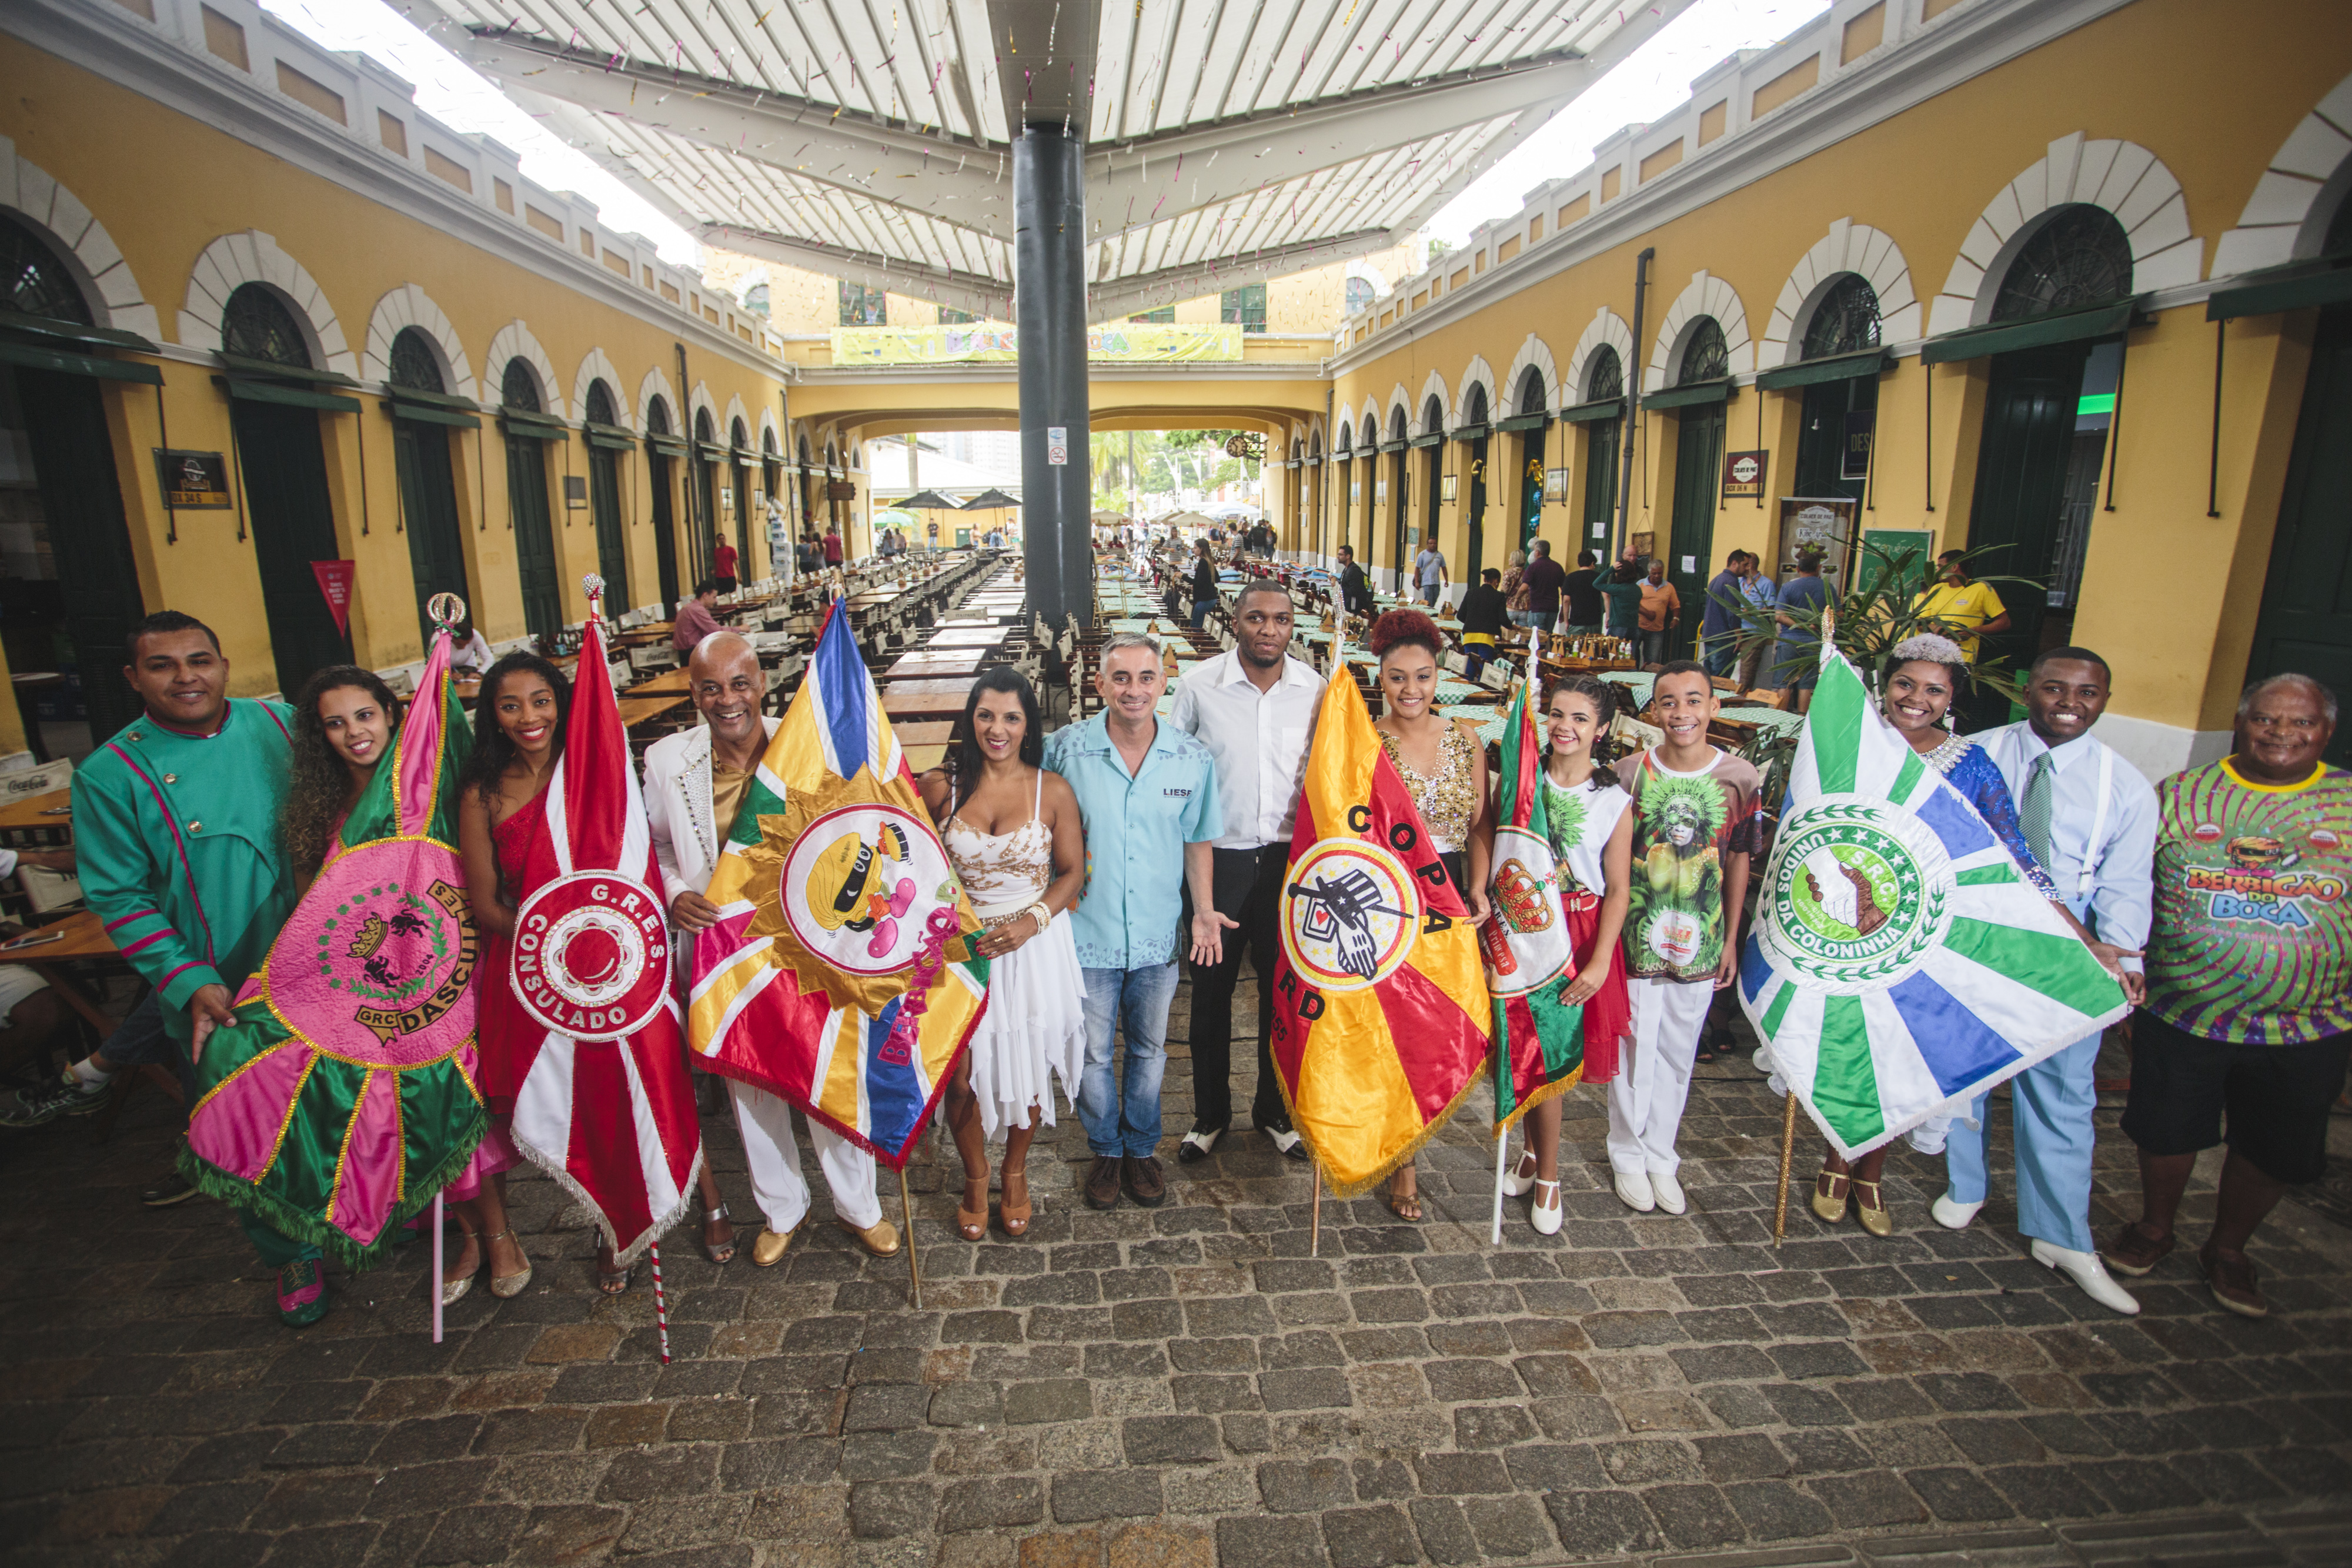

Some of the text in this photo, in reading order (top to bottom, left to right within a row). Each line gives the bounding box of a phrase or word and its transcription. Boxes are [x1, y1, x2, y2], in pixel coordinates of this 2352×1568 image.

[1347, 805, 1453, 934] COPA
[1850, 851, 1895, 902] S.R.C.
[2186, 867, 2344, 902] BERBIGÃO
[1777, 833, 1903, 958] UNIDOS DA COLONINHA
[2211, 894, 2310, 928] BOCA
[2247, 891, 2277, 904] DO
[591, 884, 664, 968] G.R.E.S.
[1488, 929, 1511, 968] Princesa
[360, 1010, 395, 1025] GRC
[401, 915, 480, 1032] DASCUIA
[415, 954, 434, 975] 2004
[519, 914, 626, 1029] CONSULADO
